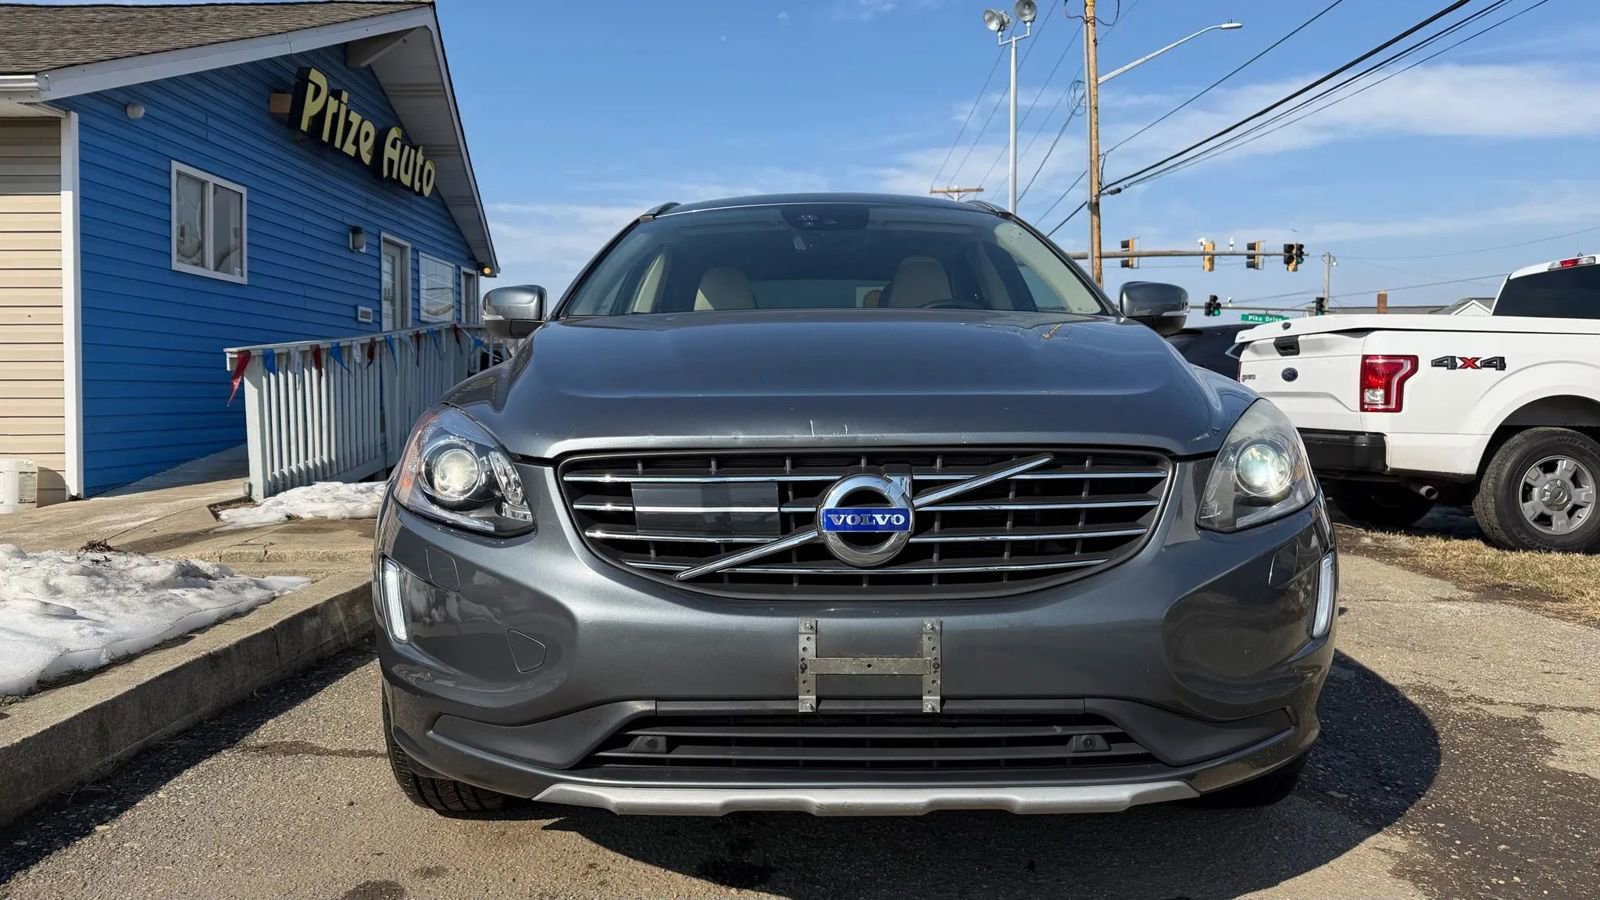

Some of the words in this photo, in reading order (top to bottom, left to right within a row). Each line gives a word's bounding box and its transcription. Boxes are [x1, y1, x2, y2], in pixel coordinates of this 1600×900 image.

[300, 67, 376, 166] Prize
[382, 126, 436, 198] Auto
[827, 513, 906, 526] VOLVO
